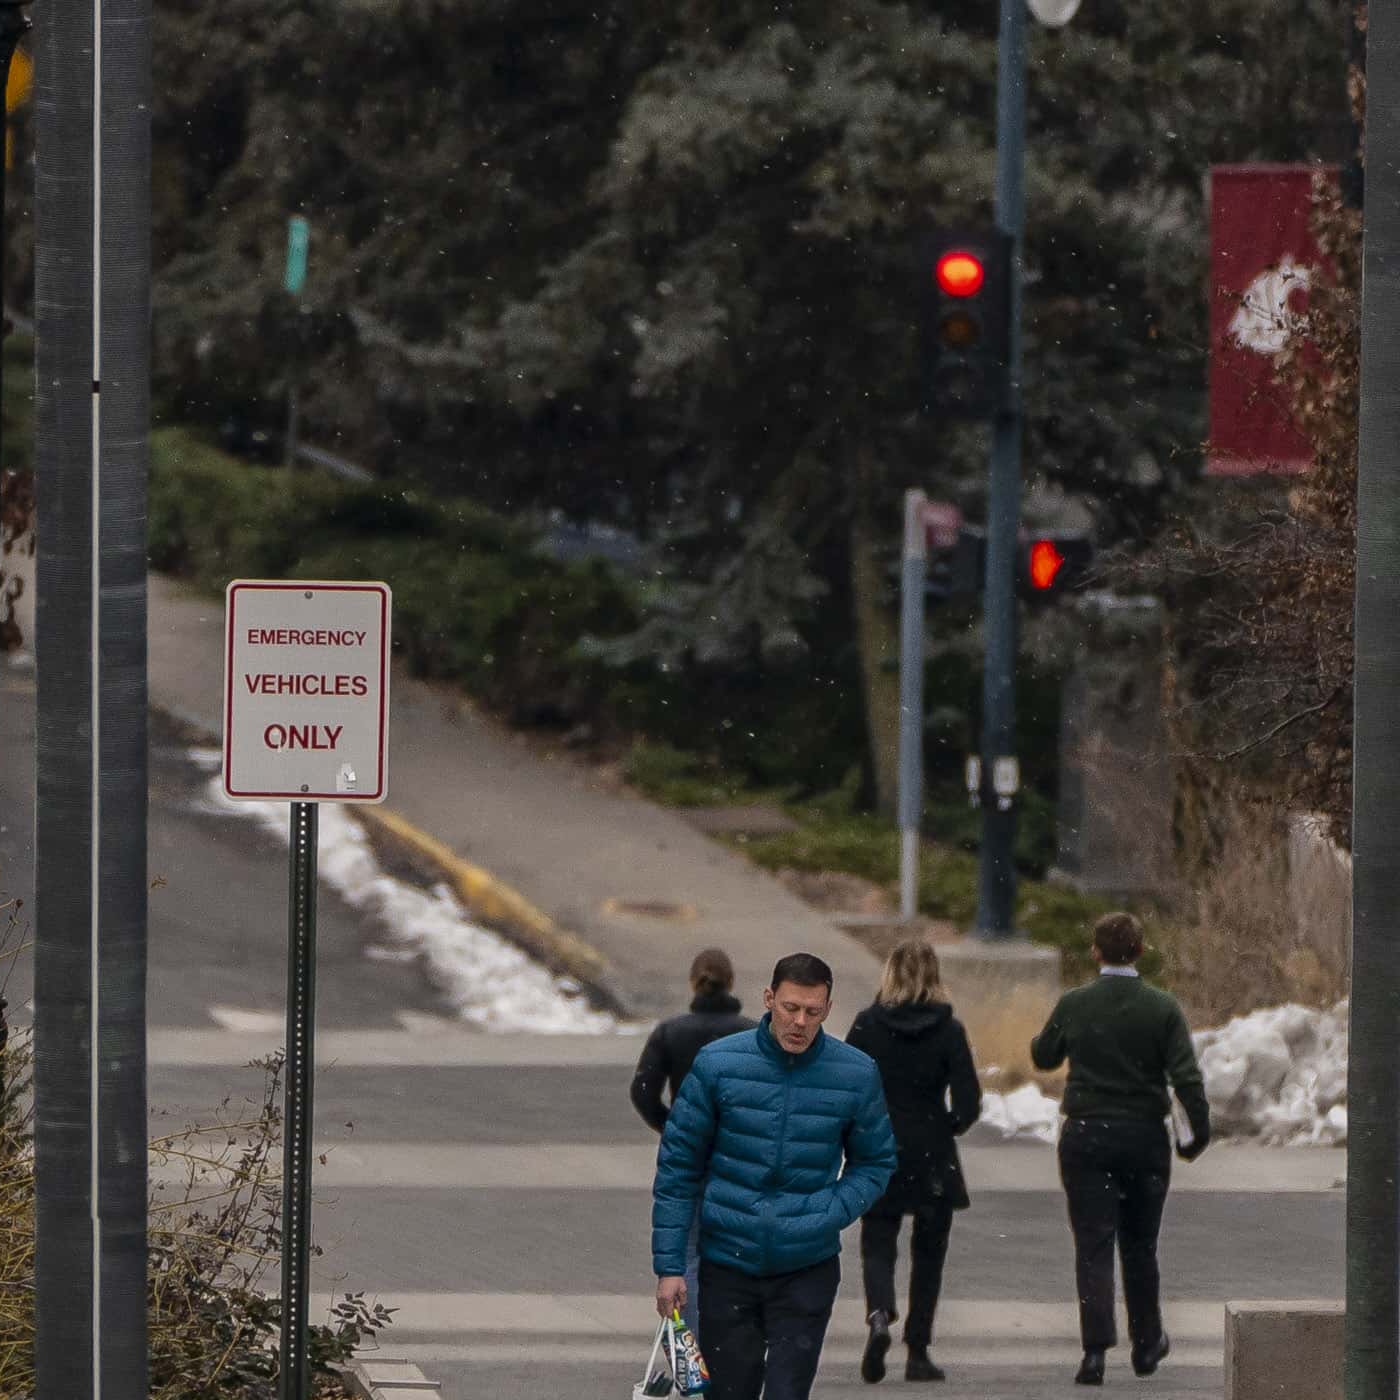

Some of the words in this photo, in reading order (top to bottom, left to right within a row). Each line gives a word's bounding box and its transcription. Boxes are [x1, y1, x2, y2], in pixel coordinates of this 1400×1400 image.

[247, 629, 366, 646] EMERGENCY
[245, 674, 368, 696] VEHICLES
[263, 724, 343, 750] ONLY
